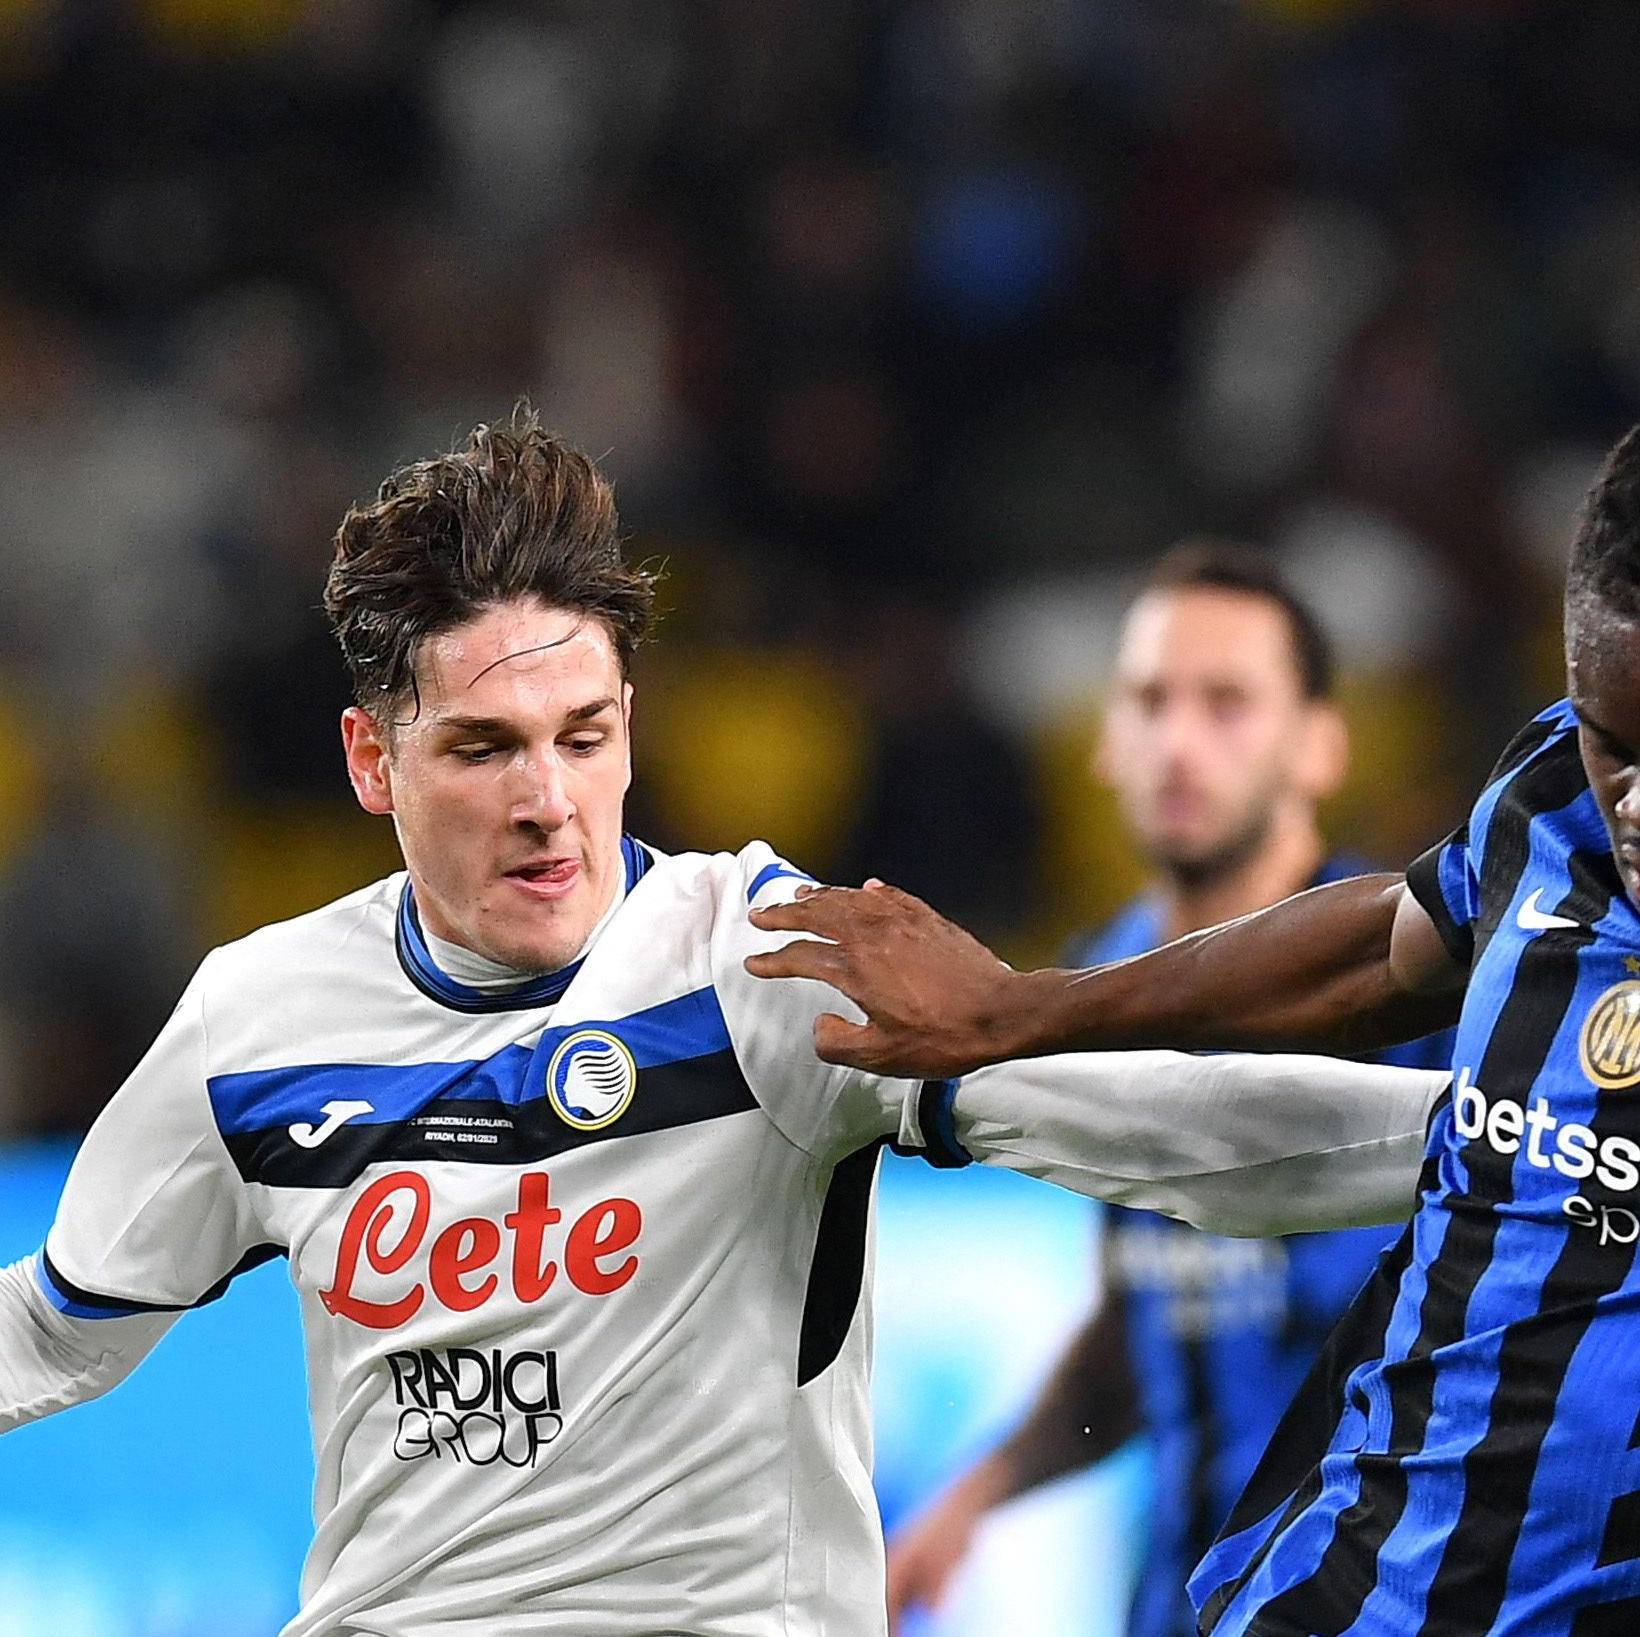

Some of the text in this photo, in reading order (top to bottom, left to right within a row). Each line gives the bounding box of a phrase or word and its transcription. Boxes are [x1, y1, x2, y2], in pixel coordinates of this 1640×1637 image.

[318, 1170, 643, 1329] Lete
[383, 1348, 561, 1413] RADICI
[393, 1408, 564, 1469] GROUP
